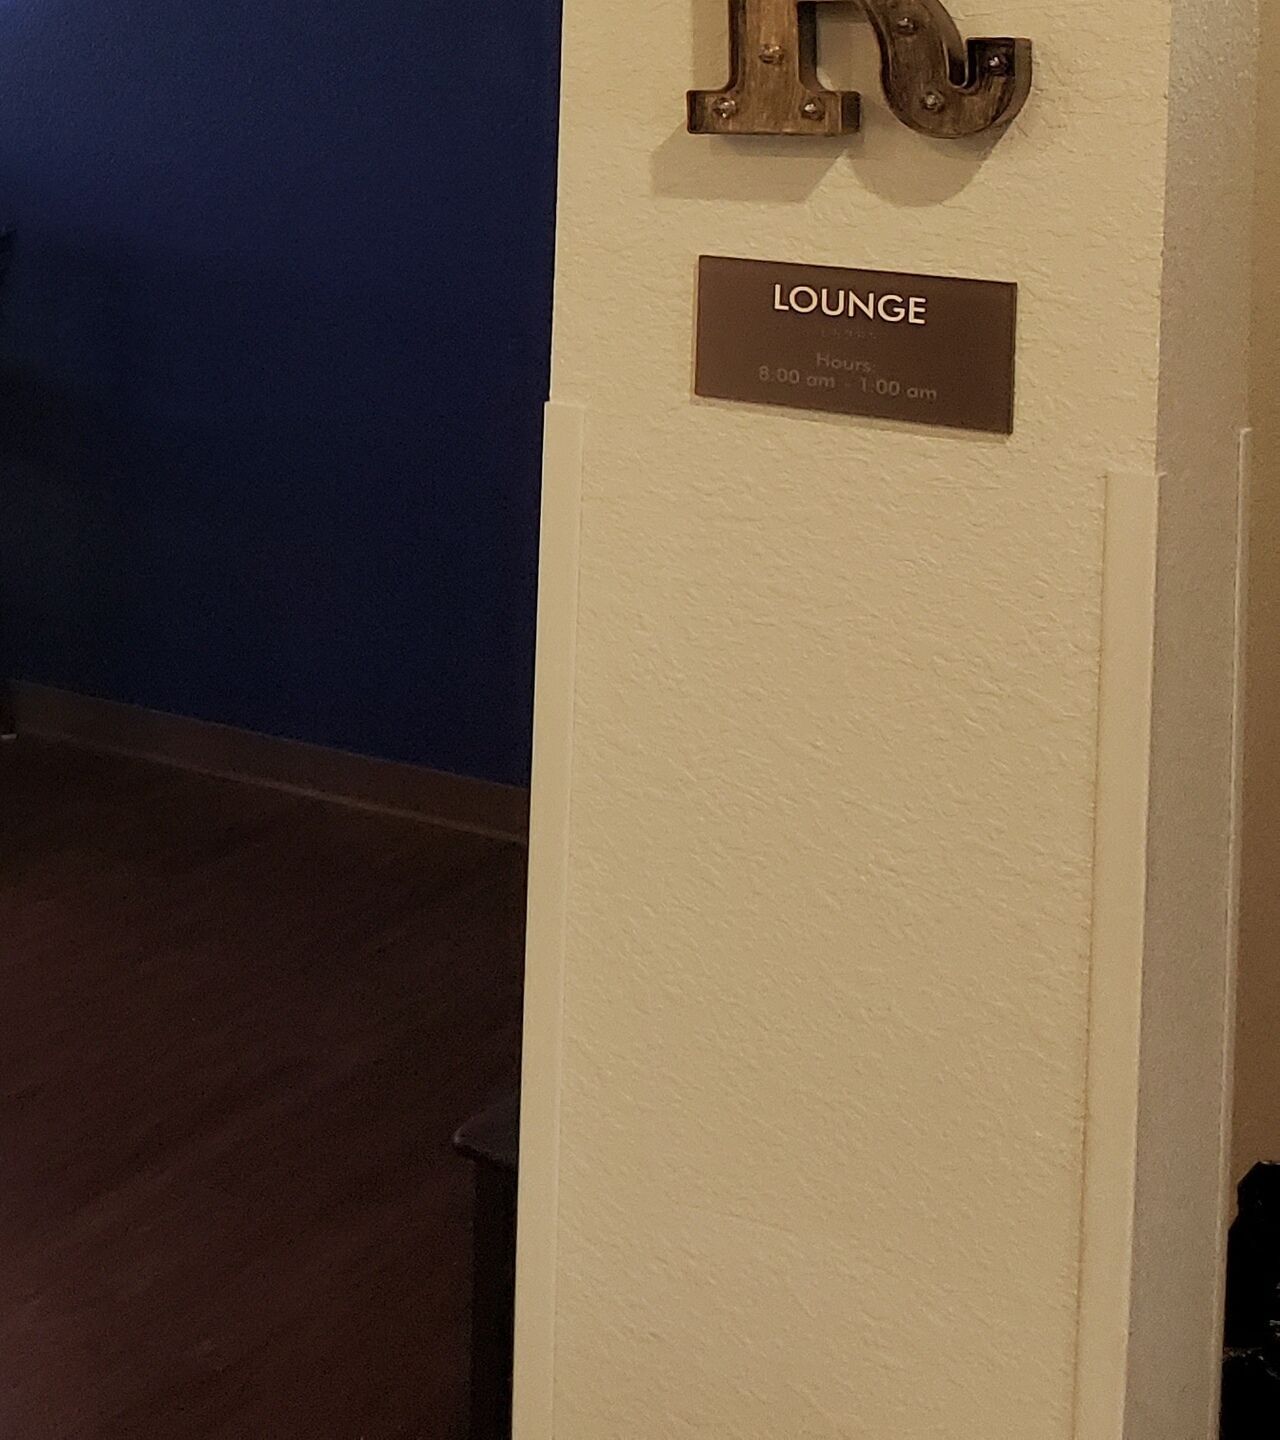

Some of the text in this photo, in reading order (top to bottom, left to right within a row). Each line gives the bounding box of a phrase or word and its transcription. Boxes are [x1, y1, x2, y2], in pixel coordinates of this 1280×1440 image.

[774, 283, 927, 325] LOUNGE
[806, 376, 836, 389] am
[906, 386, 938, 401] am
